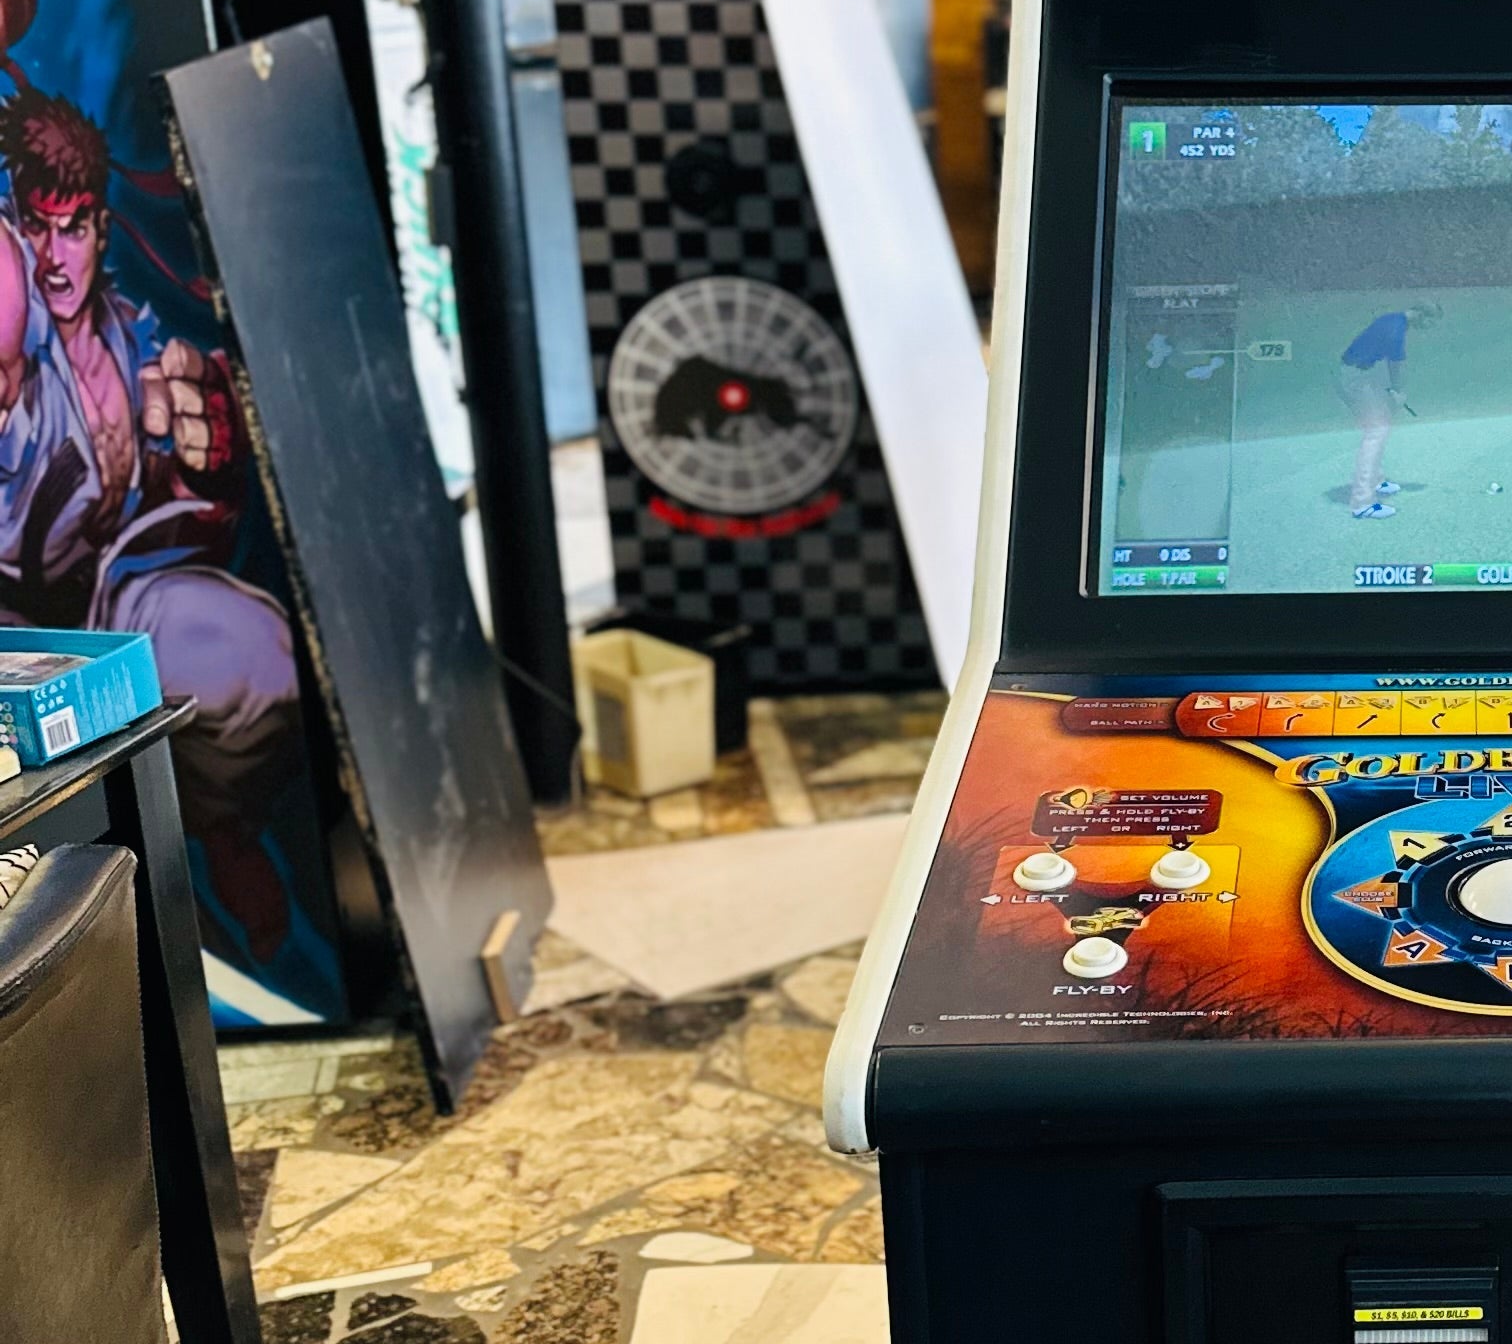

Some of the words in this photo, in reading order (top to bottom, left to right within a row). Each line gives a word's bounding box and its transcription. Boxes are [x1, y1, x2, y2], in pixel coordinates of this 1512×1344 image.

[1193, 127, 1221, 139] PAR
[1225, 127, 1235, 138] 4
[1209, 144, 1236, 157] YDS
[1354, 565, 1417, 585] STROKE
[1422, 566, 1433, 584] 2
[1402, 836, 1426, 850] 1
[1010, 893, 1070, 904] LEFT
[1138, 892, 1212, 903] RIGHT
[1471, 935, 1512, 947] BACK
[1395, 939, 1429, 959] A
[1052, 984, 1133, 996] FLY-BY
[1446, 1309, 1470, 1318] BILLS
